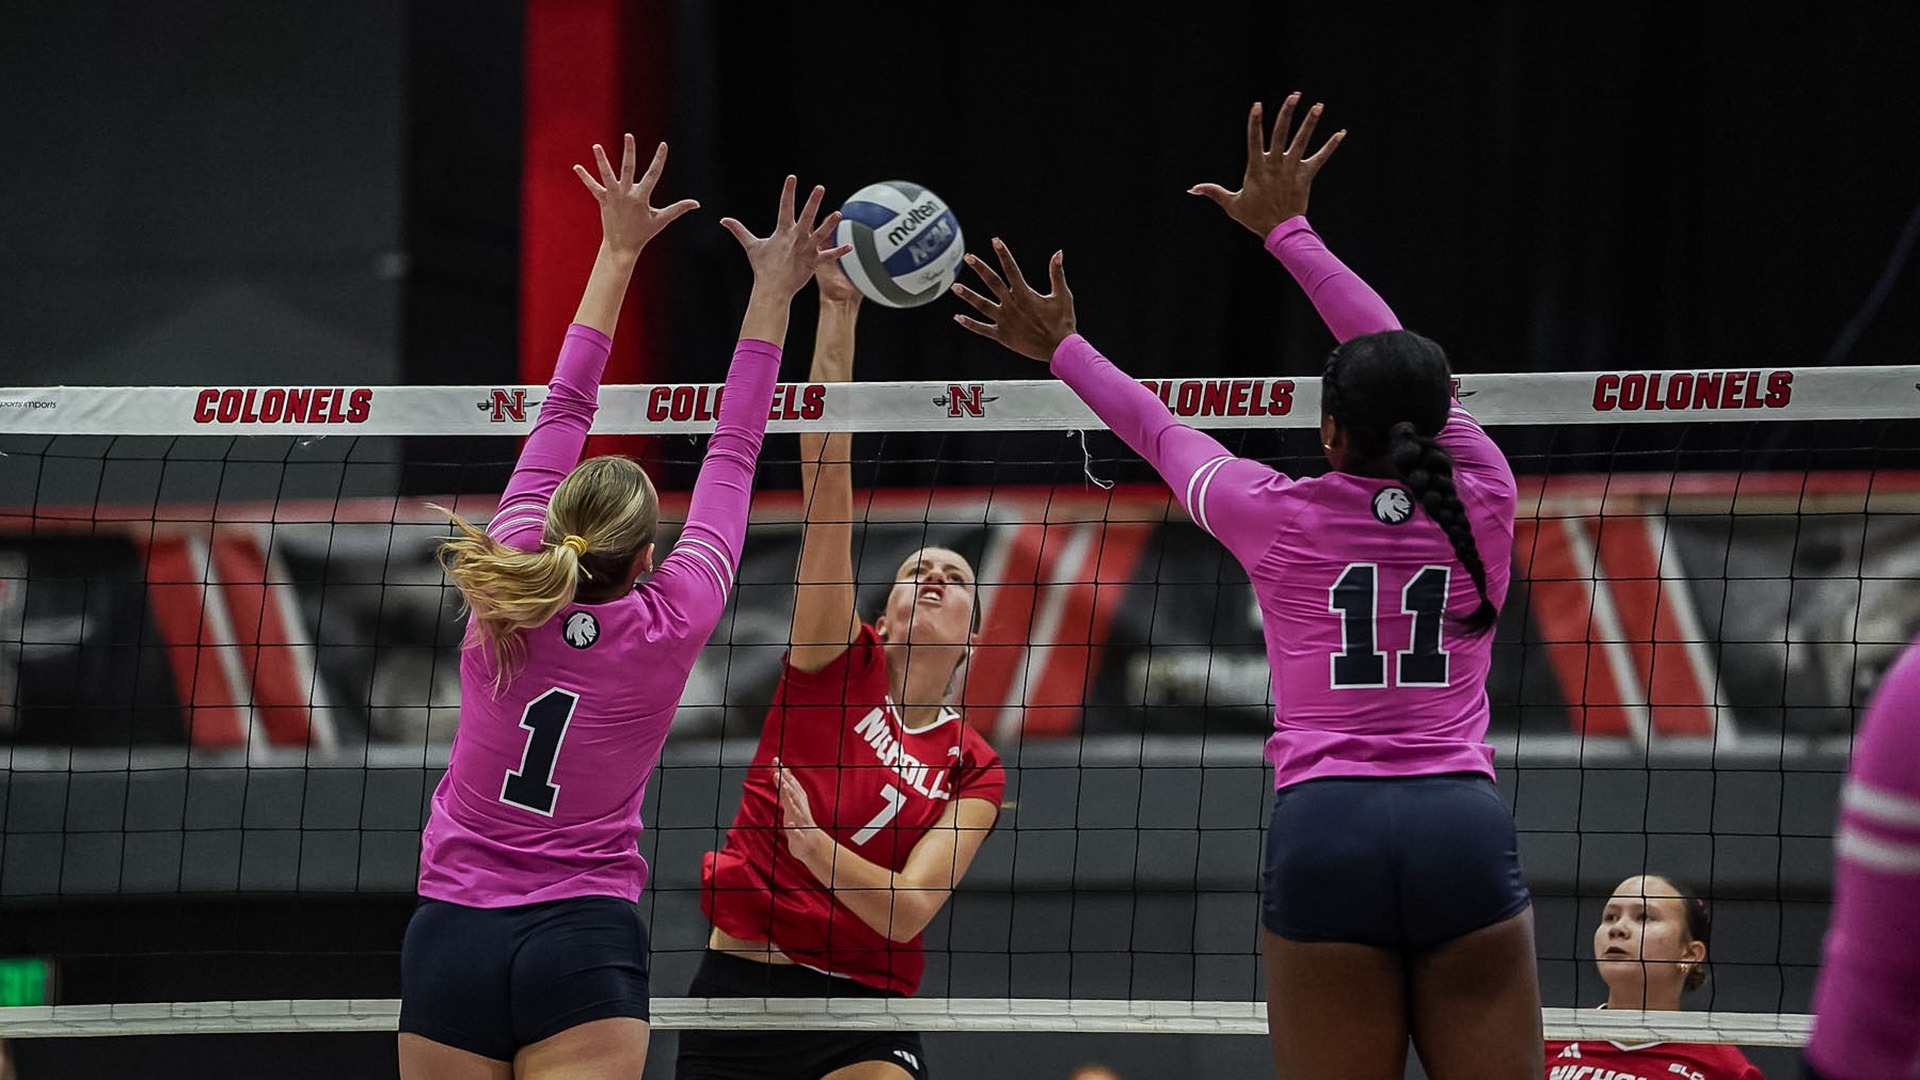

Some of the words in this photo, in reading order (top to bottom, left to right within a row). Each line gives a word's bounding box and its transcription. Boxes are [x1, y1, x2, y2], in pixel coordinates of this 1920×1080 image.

[887, 200, 940, 247] molten
[193, 388, 374, 424] COLONELS
[490, 388, 527, 422] N
[646, 384, 827, 422] COLELS
[947, 383, 985, 418] N
[1138, 379, 1295, 417] LONELS
[1592, 370, 1794, 412] COLONELS
[1328, 562, 1452, 690] 11
[498, 686, 581, 818] 1
[853, 706, 952, 800] NICHOLL
[850, 783, 908, 847] 7
